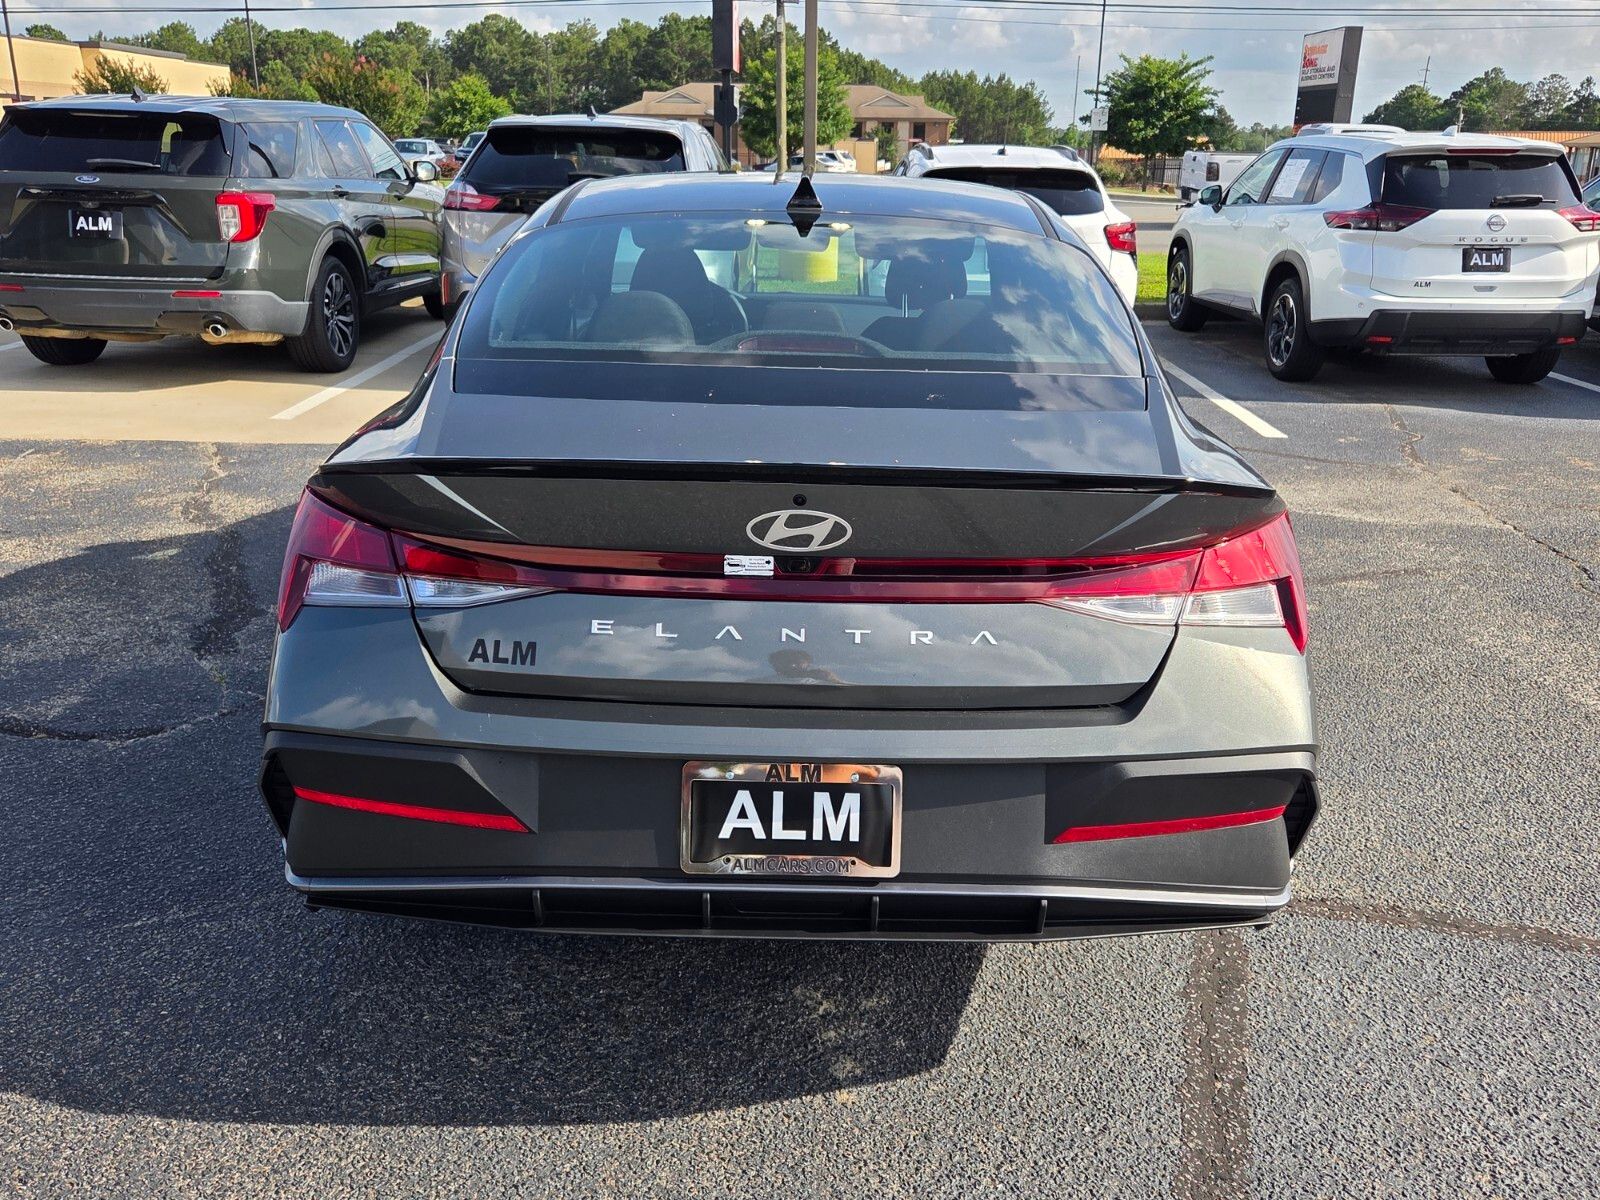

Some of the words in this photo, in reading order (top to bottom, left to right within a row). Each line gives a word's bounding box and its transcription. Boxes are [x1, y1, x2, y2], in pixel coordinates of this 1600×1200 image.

[76, 216, 113, 231] ALM
[1470, 253, 1504, 266] ALM
[590, 619, 998, 646] ELANTRA
[468, 638, 537, 666] ALM
[764, 763, 823, 783] ALM
[718, 789, 861, 842] ALM
[730, 857, 851, 873] ALMCARS.COM
